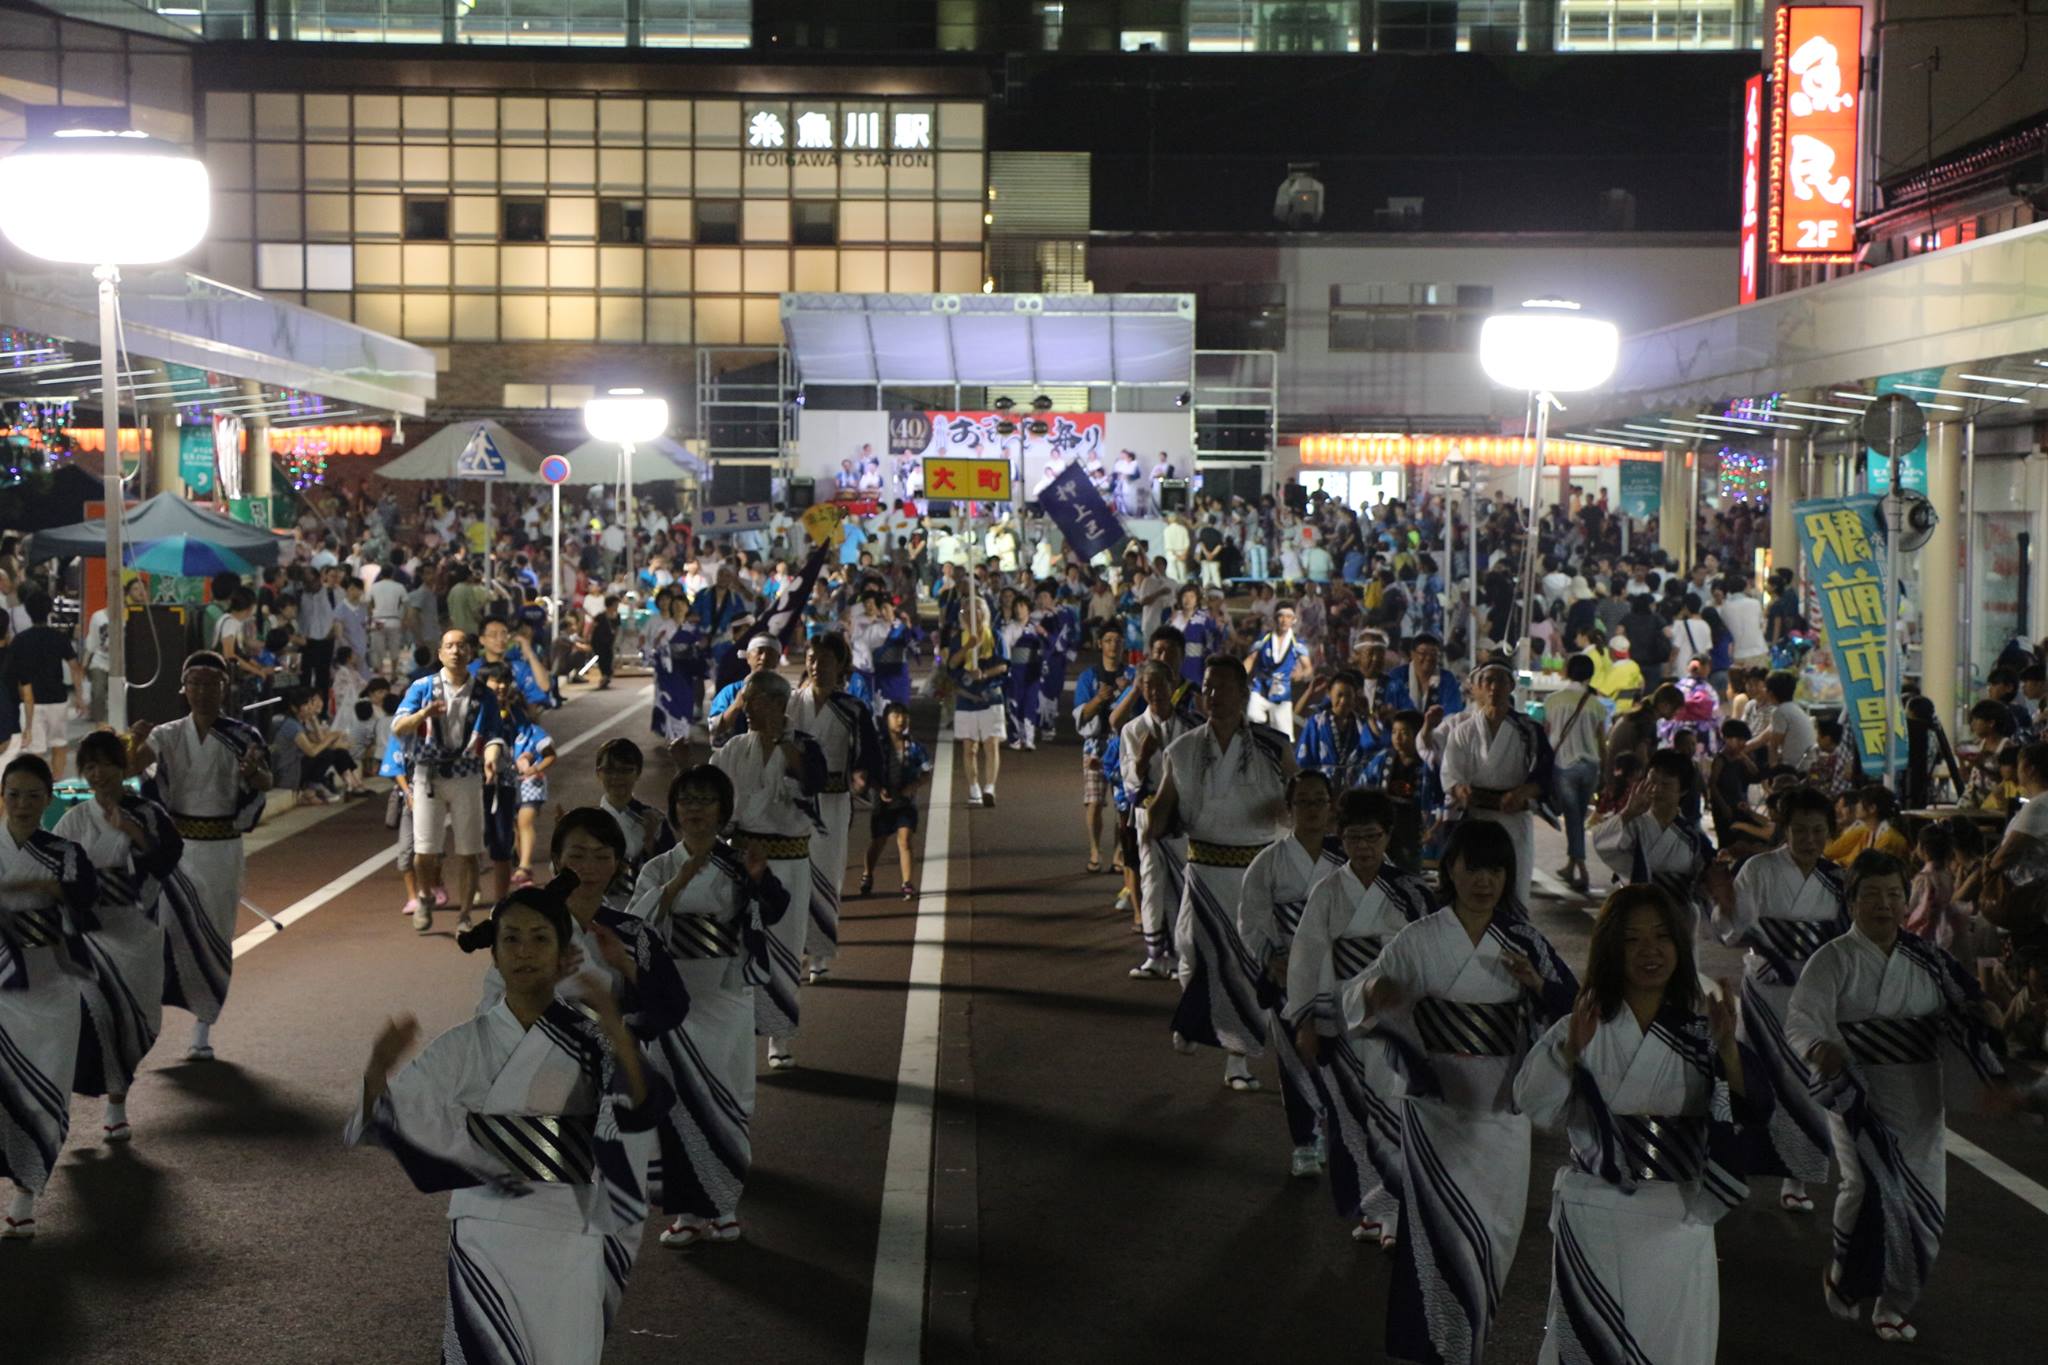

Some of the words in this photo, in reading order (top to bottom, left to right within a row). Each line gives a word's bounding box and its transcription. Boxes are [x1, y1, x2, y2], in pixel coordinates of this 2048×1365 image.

[749, 111, 931, 148] 糸魚川駅
[750, 152, 837, 168] ITOIGAWA
[854, 152, 929, 168] STATION
[1796, 219, 1838, 249] 2F
[932, 466, 1002, 492] 大町
